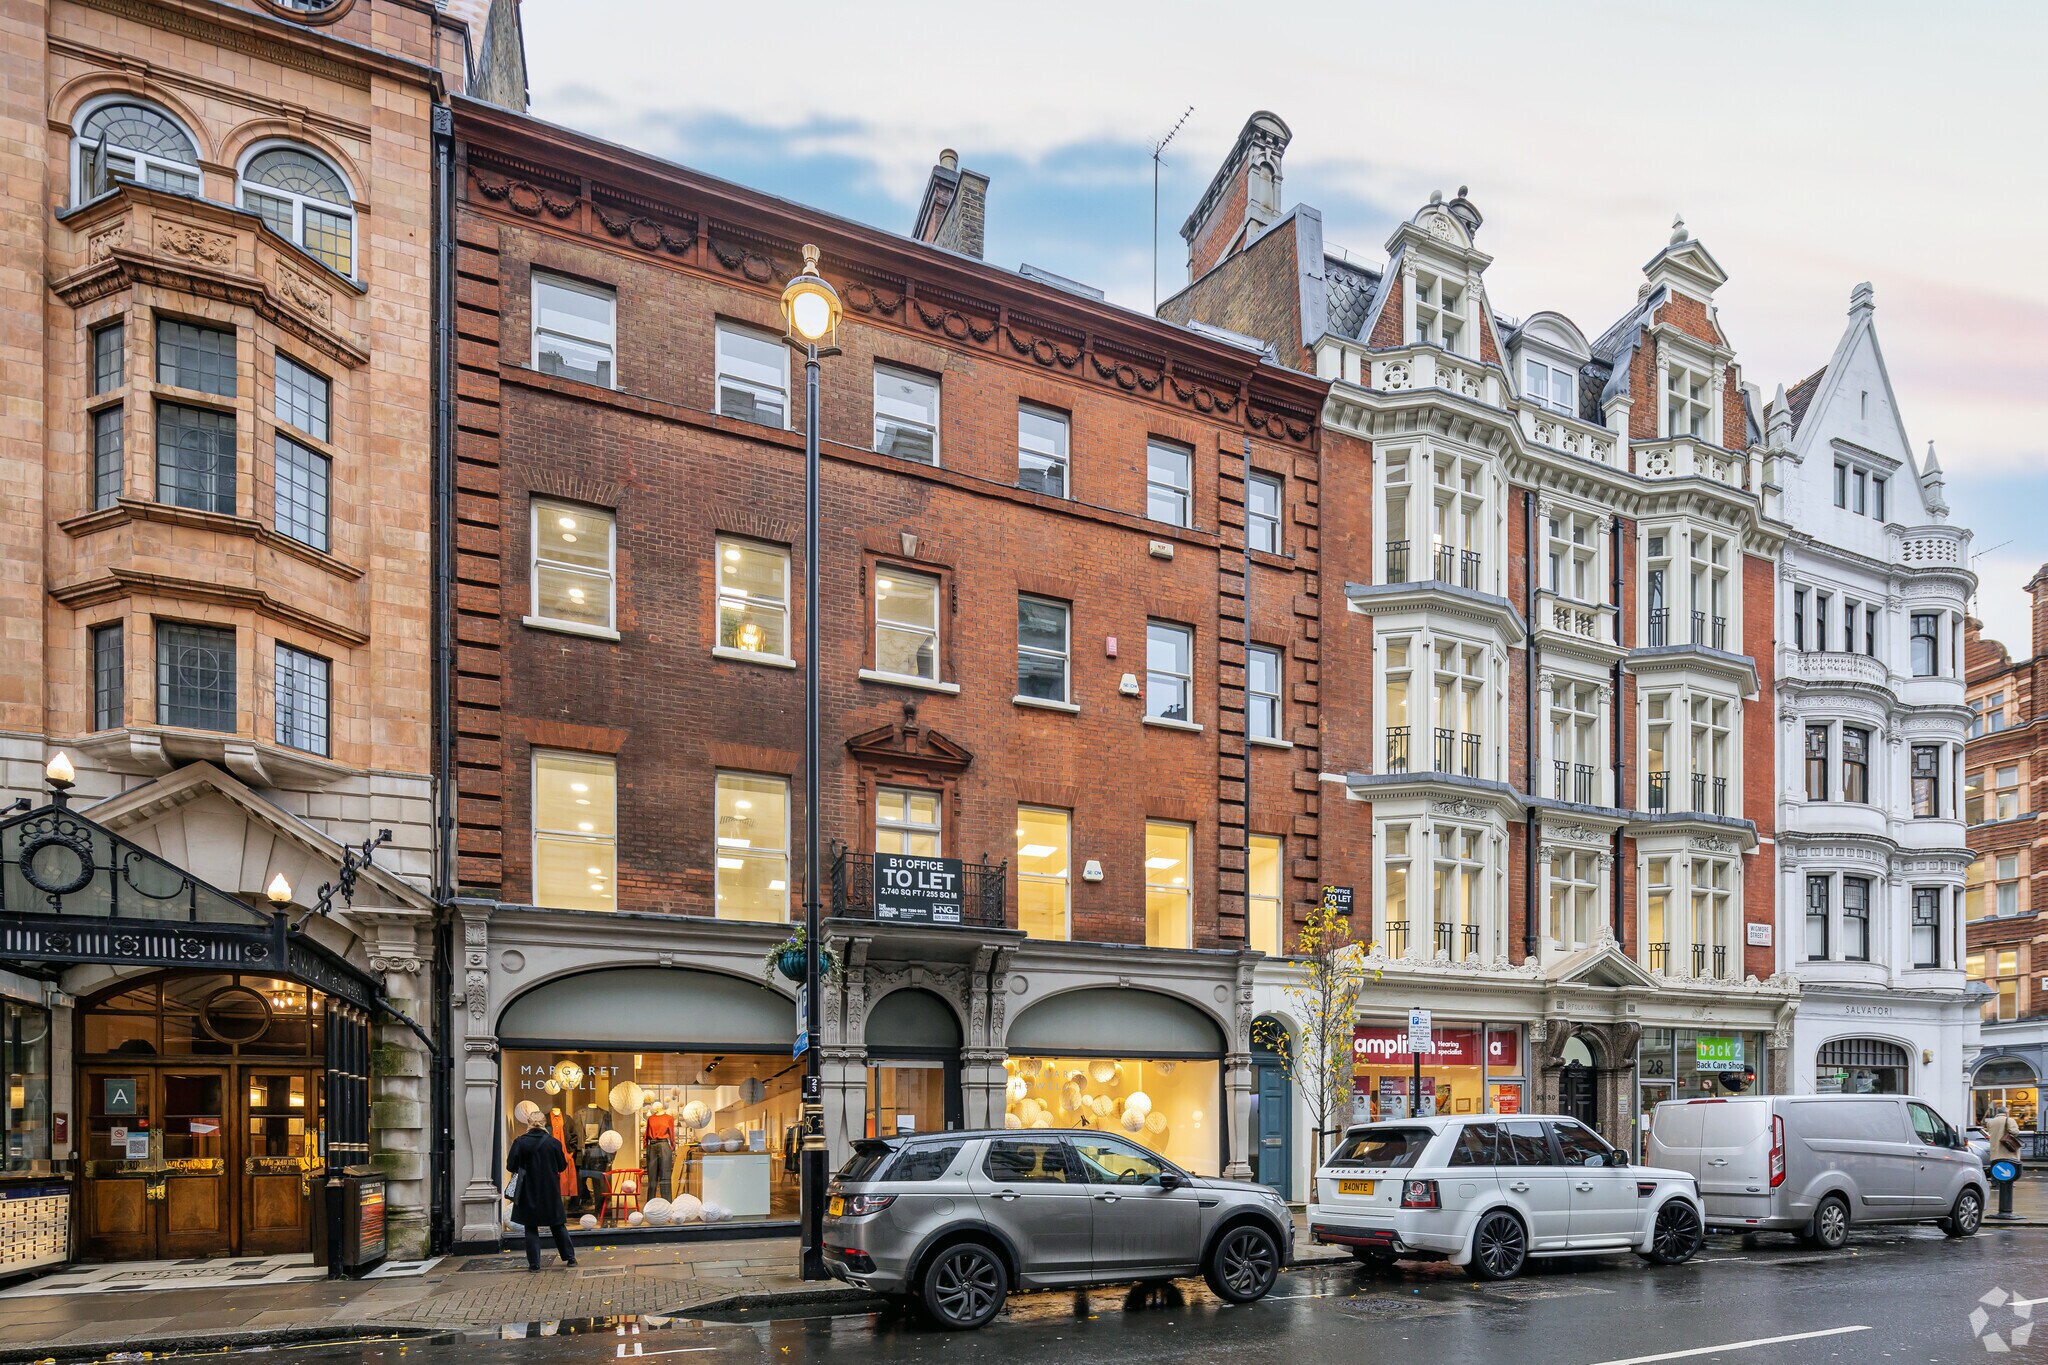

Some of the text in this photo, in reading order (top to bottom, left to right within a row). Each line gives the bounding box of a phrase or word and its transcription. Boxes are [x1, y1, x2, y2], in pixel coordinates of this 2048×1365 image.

[890, 858, 944, 871] B1 OFFICE
[883, 868, 955, 890] TO LET
[1845, 1005, 1892, 1015] SALVATORI
[1490, 1042, 1501, 1055] a
[521, 1066, 619, 1076] MARGARET
[1648, 1060, 1663, 1074] 28
[1729, 1062, 1744, 1070] Shop
[1015, 1070, 1085, 1079] MARGARET
[521, 1080, 596, 1090] HOWELL
[113, 1089, 128, 1104] A
[165, 1160, 213, 1170] WIGMORE
